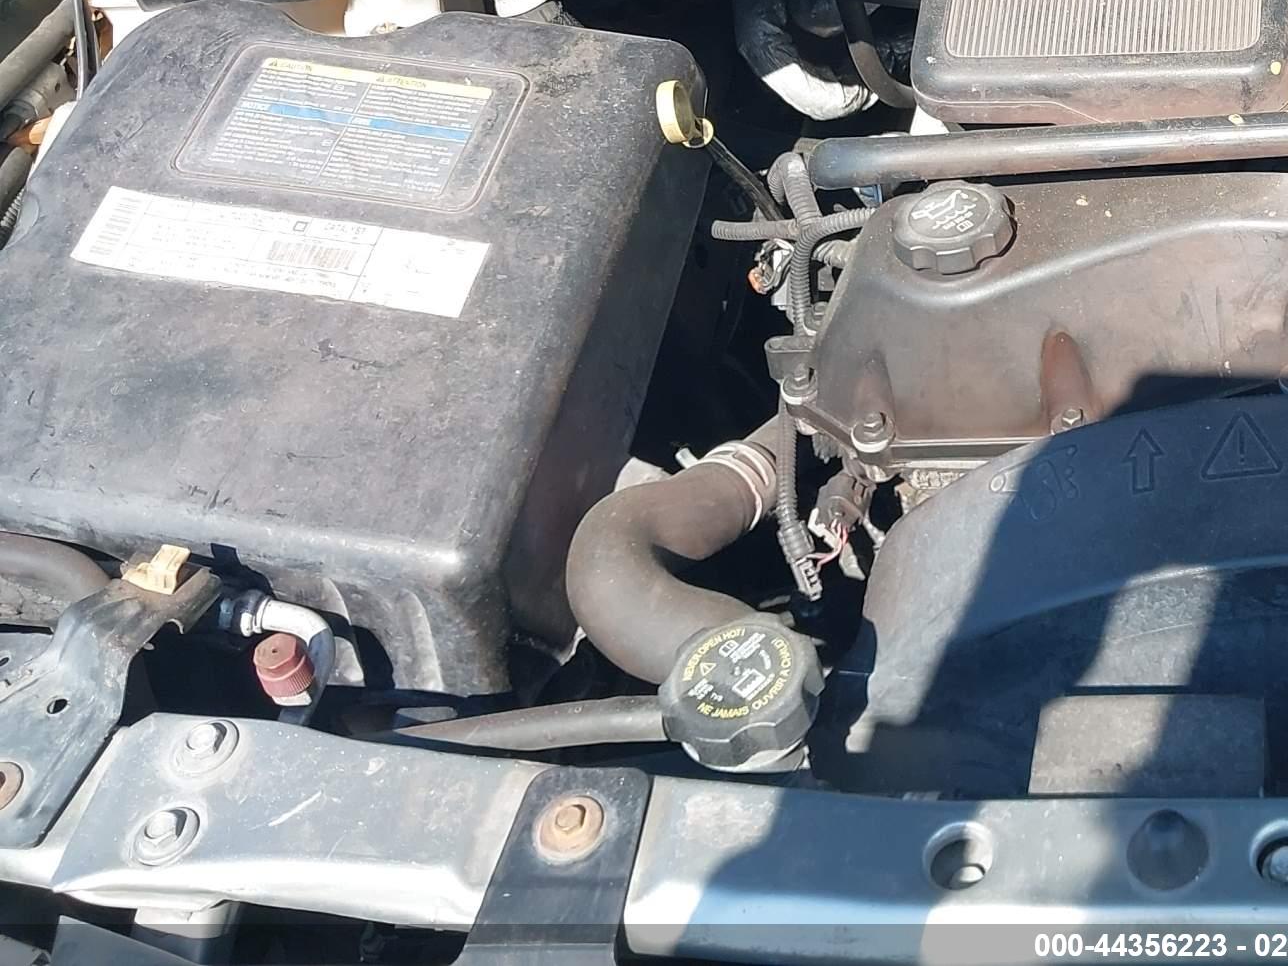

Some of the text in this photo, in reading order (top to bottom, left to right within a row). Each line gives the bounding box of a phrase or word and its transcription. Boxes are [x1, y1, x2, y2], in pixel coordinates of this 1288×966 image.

[700, 635, 723, 656] OPEN
[722, 628, 746, 642] HOT!
[697, 701, 712, 715] NE
[711, 705, 750, 719] JAMAIS
[752, 677, 788, 709] OUVRIR
